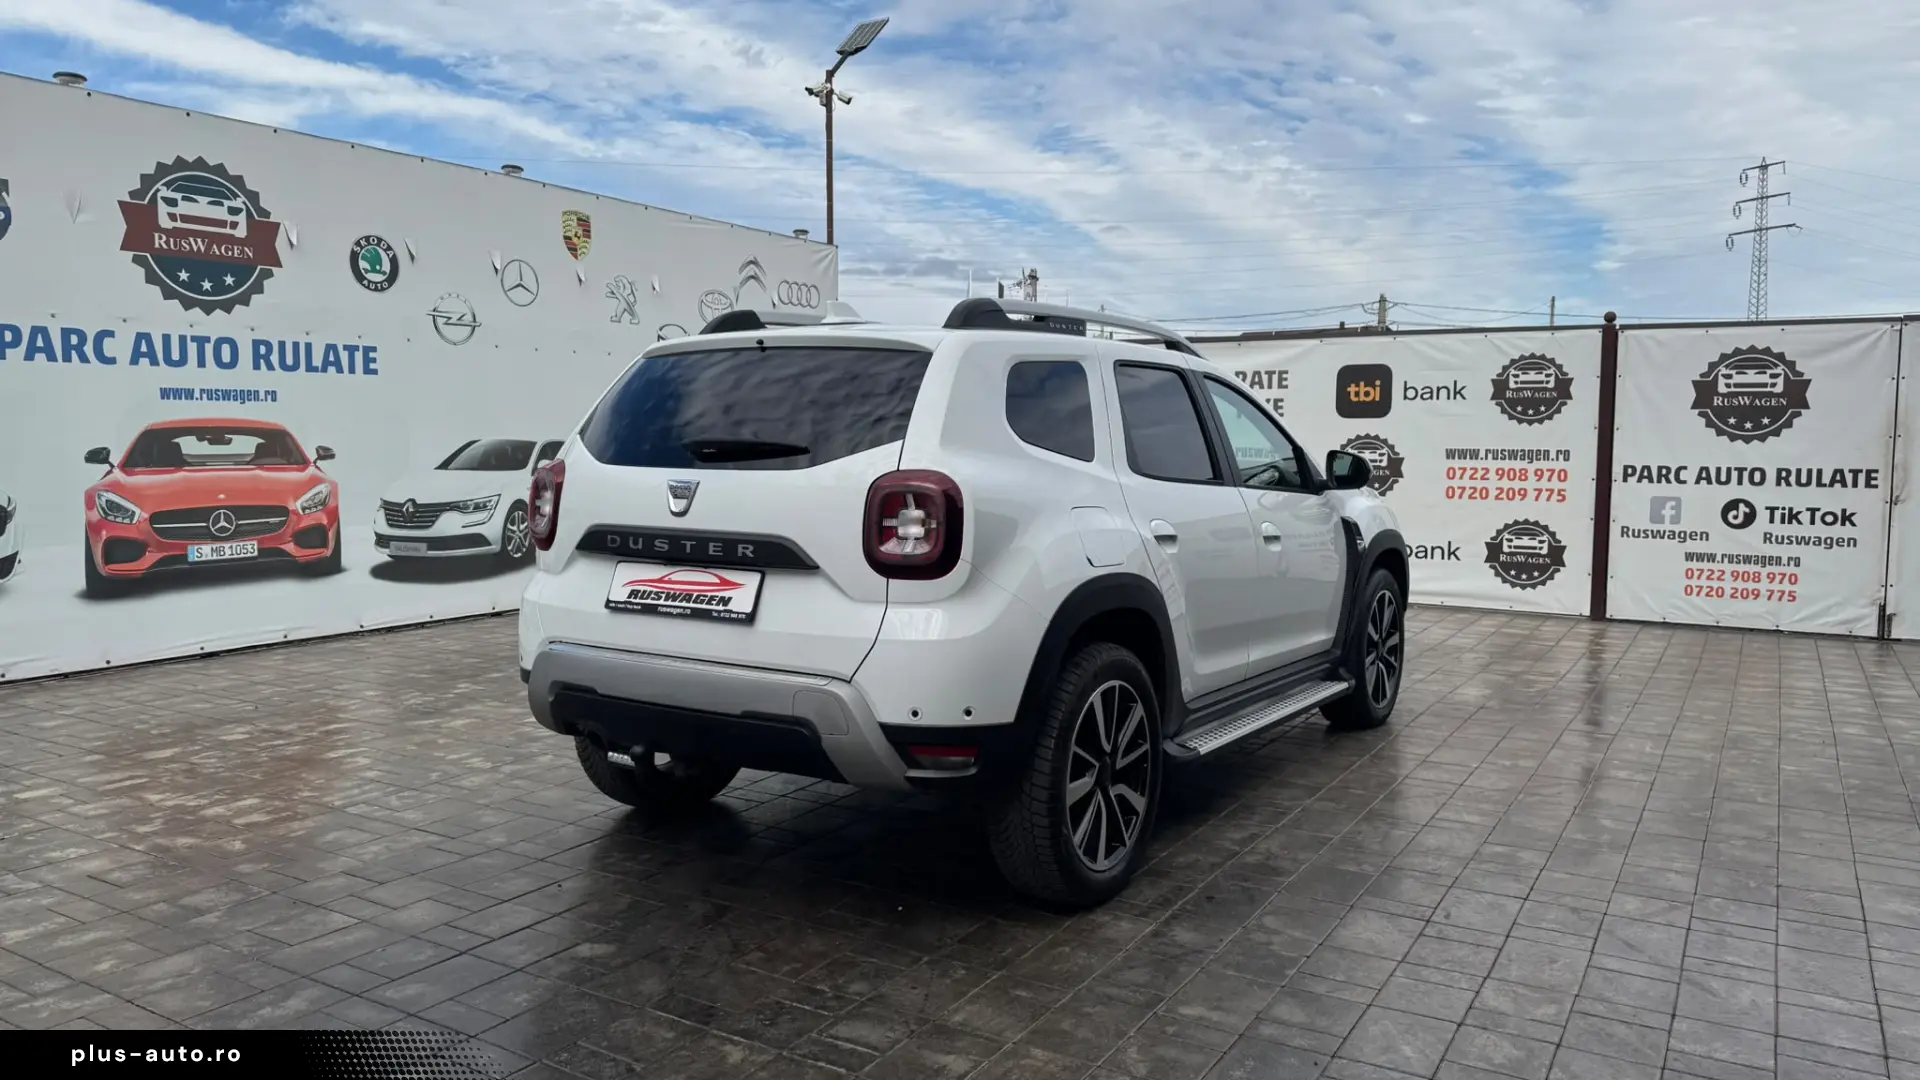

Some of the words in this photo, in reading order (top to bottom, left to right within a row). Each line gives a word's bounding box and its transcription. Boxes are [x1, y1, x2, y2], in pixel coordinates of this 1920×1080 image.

[362, 279, 389, 290] AUTO
[1049, 322, 1085, 331] DUSTER
[0, 323, 117, 366] PARC
[129, 331, 239, 371] AUTO
[251, 338, 379, 376] RULATE
[159, 386, 278, 405] www.ruswagen.ro
[1346, 379, 1381, 403] tbi
[1403, 379, 1467, 401] bank
[1445, 446, 1571, 464] www.ruswagen.ro
[1446, 466, 1491, 482] 0722
[1495, 467, 1529, 483] 908
[1533, 468, 1568, 483] 970
[1621, 464, 1688, 485] PARC
[1694, 466, 1767, 487] AUTO
[1775, 468, 1880, 489] RULATE
[1445, 485, 1490, 500] 0720
[1494, 486, 1528, 502] 209
[1533, 488, 1567, 503] 775
[1764, 506, 1858, 528] TikTok
[1620, 525, 1710, 543] Ruswagen
[1762, 532, 1858, 549] Ruswagen
[228, 543, 256, 557] 1053
[607, 534, 755, 558] DUSTER
[1684, 551, 1801, 568] www.ruswagen.ro
[1684, 568, 1726, 582] 0722
[1730, 569, 1762, 584] 908
[1766, 571, 1799, 586] 970
[626, 588, 733, 608] RUSWAGEN
[1684, 585, 1725, 599] 0720
[1729, 586, 1761, 600] 209
[1765, 588, 1797, 602] 775
